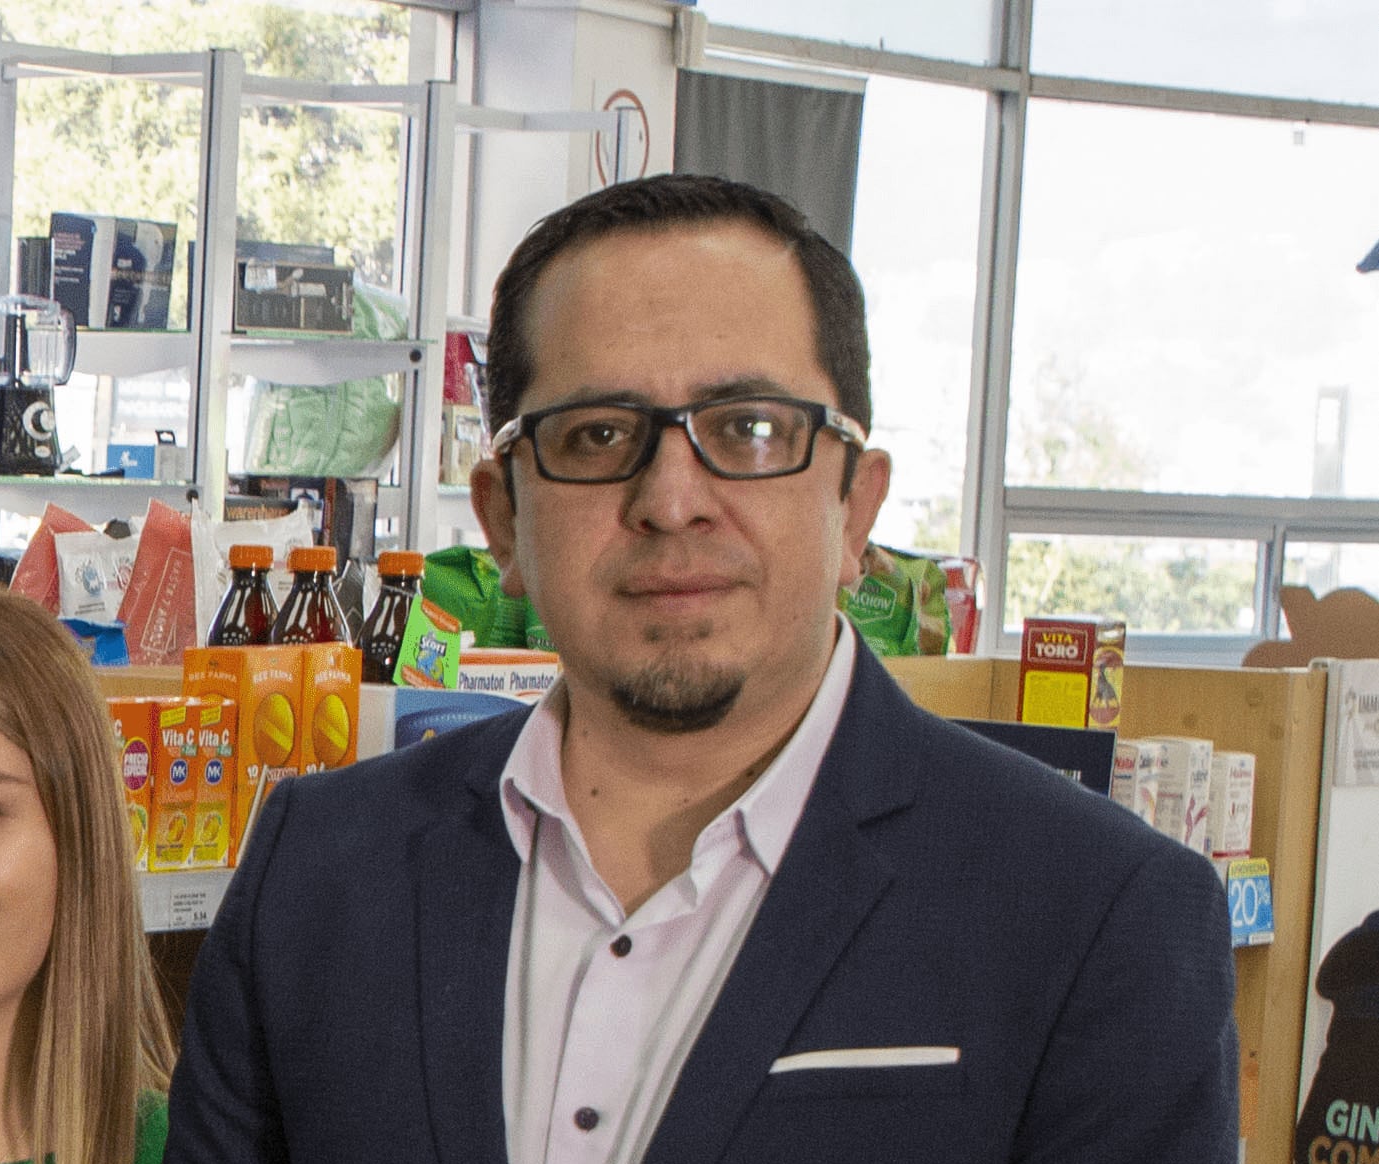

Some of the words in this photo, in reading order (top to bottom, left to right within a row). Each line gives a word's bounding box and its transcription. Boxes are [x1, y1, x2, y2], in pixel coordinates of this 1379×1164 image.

[1042, 633, 1075, 644] VITA
[1035, 643, 1078, 660] TORO
[459, 672, 504, 691] Pharmaton
[162, 730, 183, 746] Vita
[186, 729, 194, 745] C
[199, 731, 219, 746] Vita
[222, 729, 229, 745] C
[125, 753, 149, 765] PRECIO
[173, 766, 186, 778] MK
[207, 766, 221, 778] MK
[247, 765, 259, 778] 10
[1231, 879, 1271, 928] 20%
